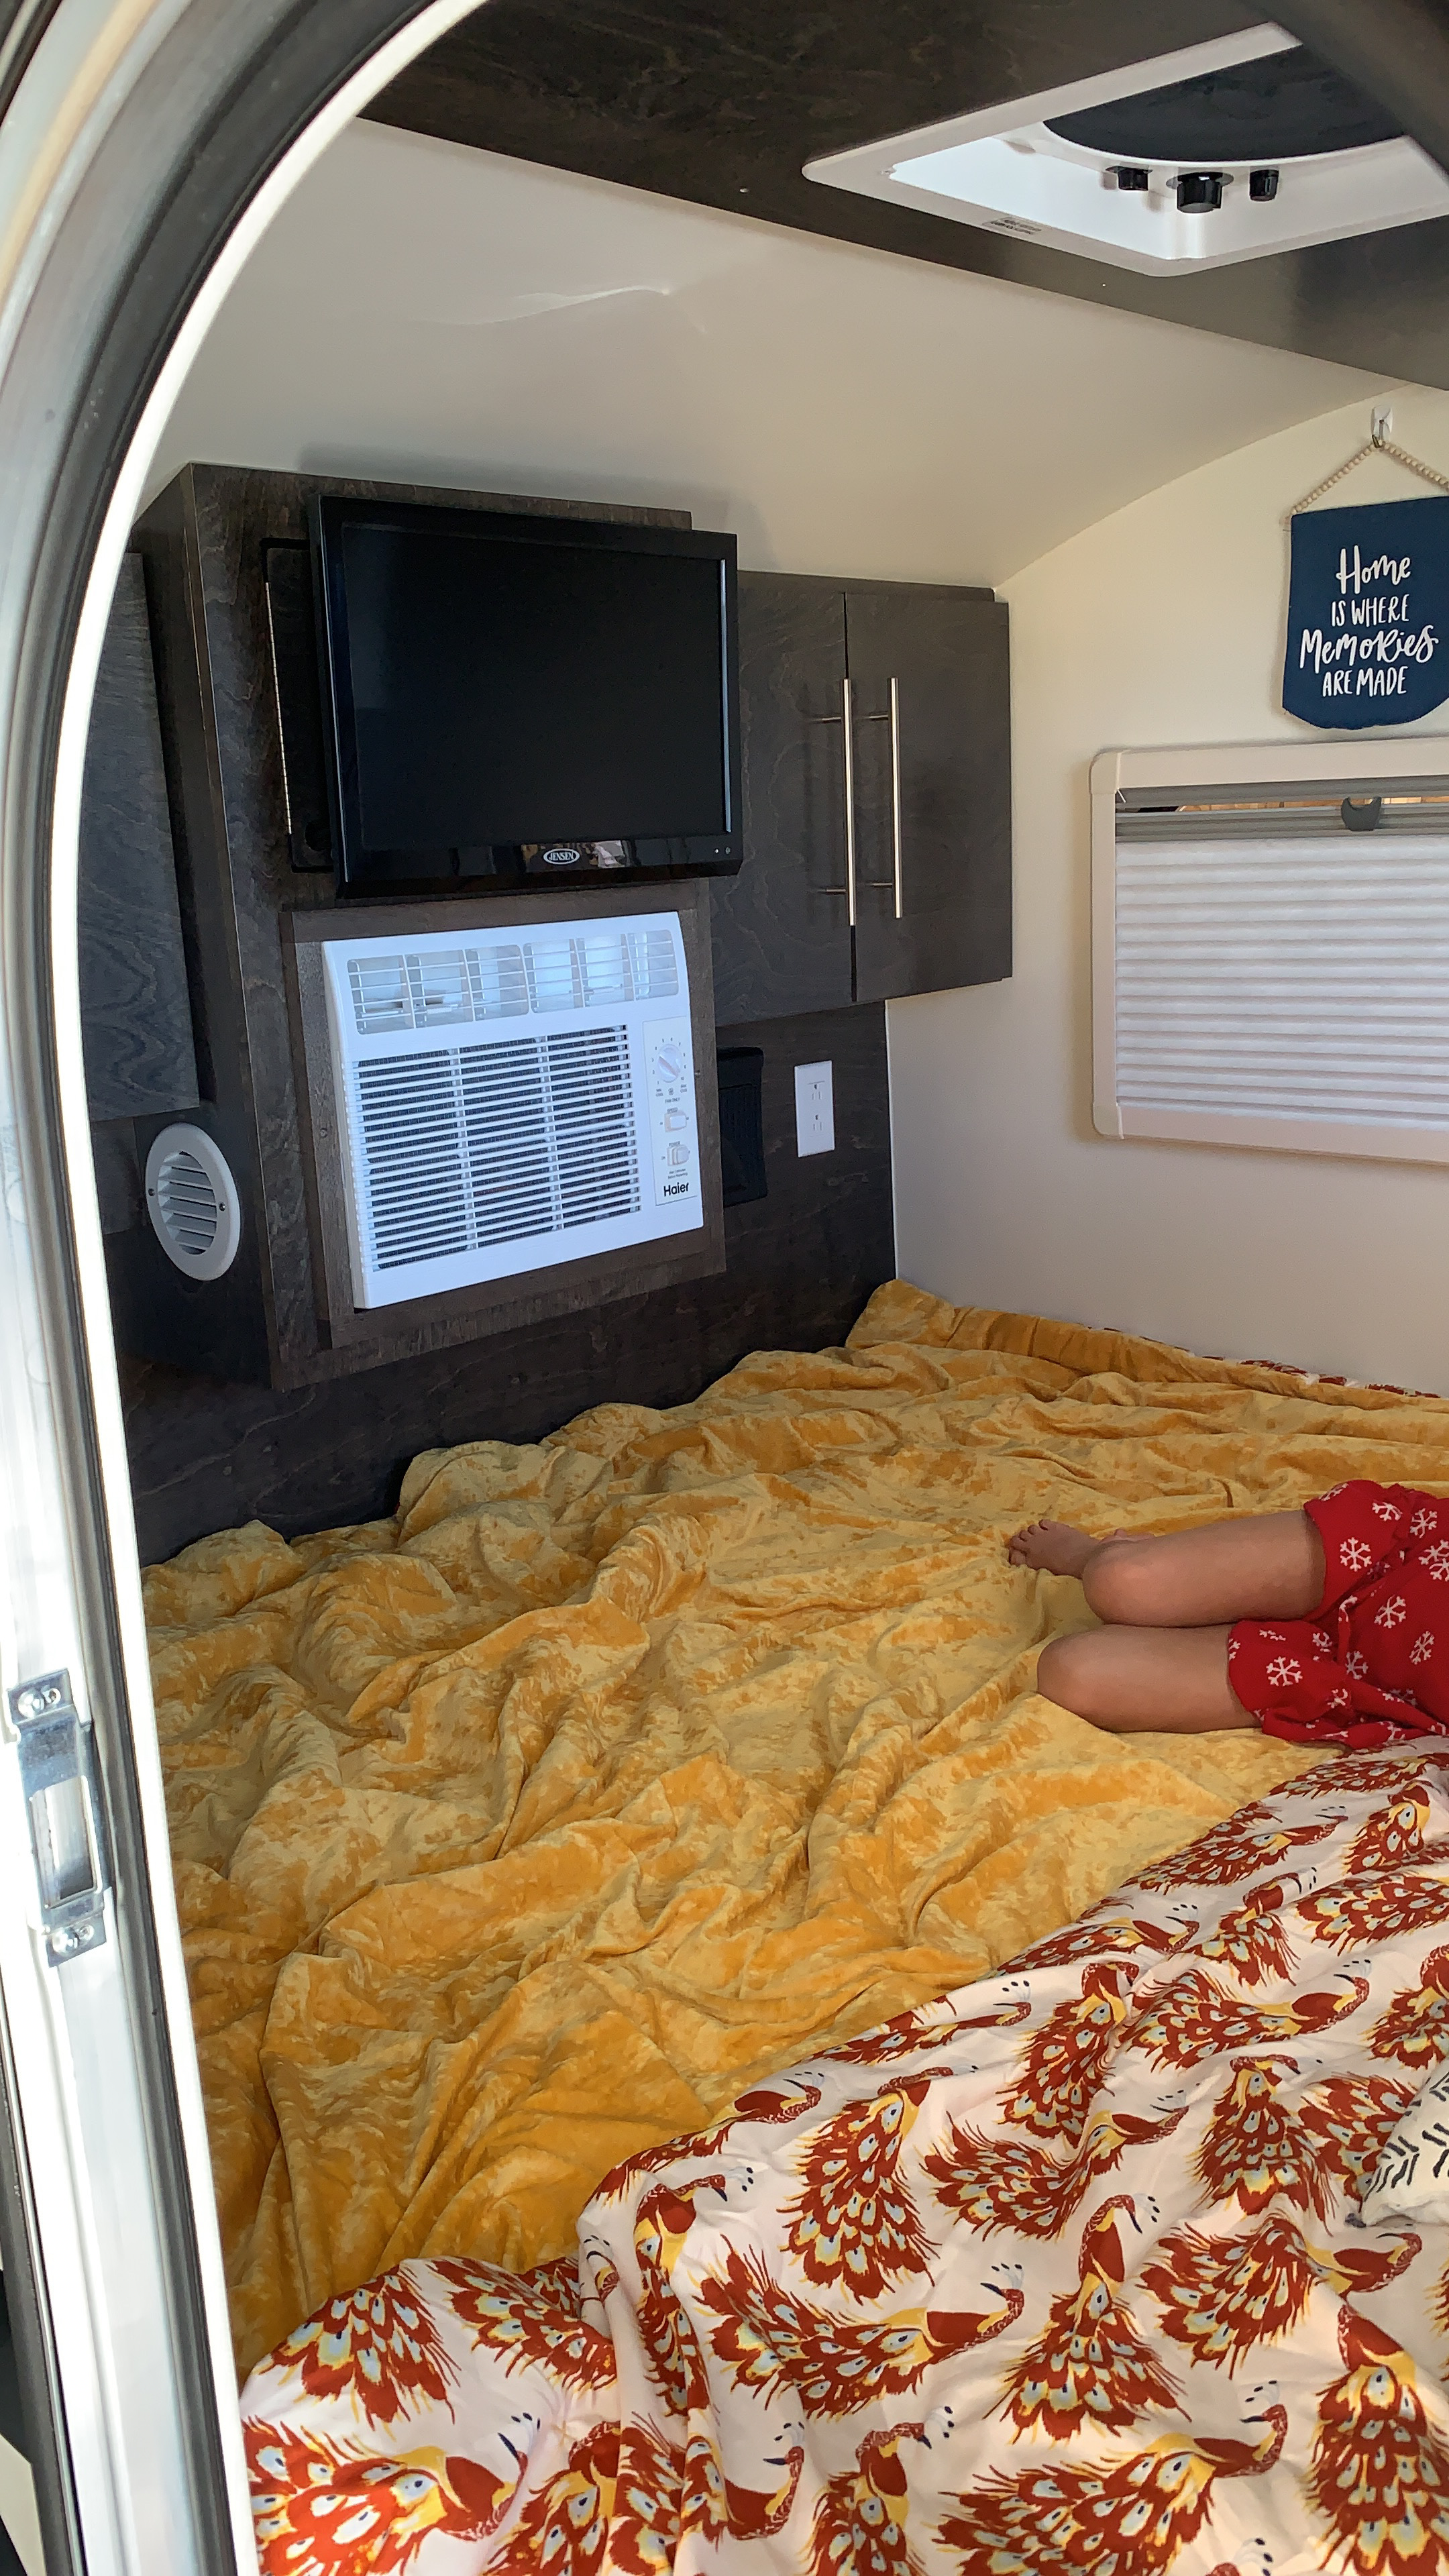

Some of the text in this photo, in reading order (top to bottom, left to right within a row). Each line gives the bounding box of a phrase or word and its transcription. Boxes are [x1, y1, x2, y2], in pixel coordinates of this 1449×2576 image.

[1336, 545, 1411, 594] Home
[1332, 594, 1409, 627] IS WHERE
[1322, 665, 1408, 697] ARE MADE
[548, 852, 575, 861] JENSEN
[663, 1182, 689, 1197] Haier
